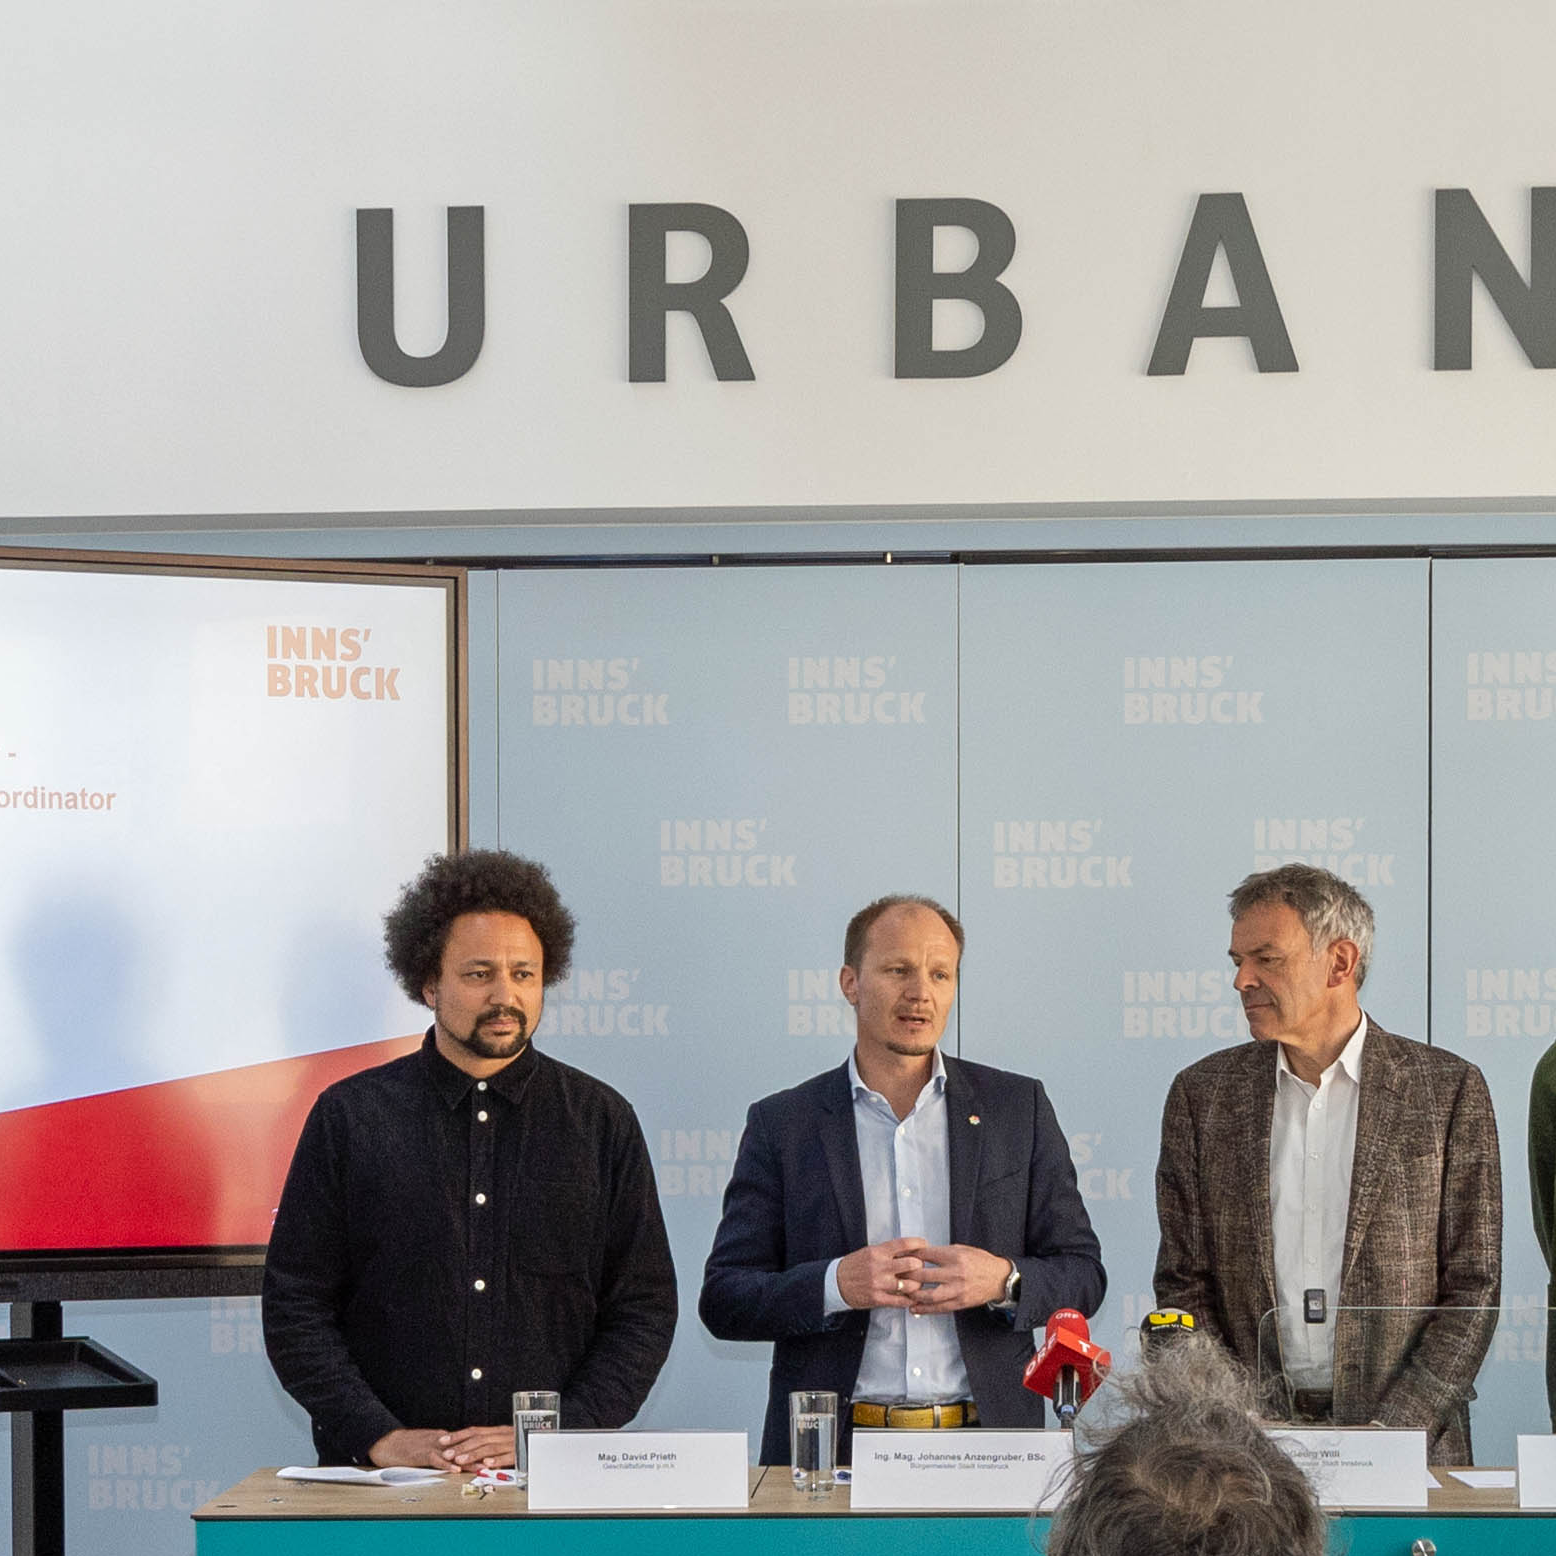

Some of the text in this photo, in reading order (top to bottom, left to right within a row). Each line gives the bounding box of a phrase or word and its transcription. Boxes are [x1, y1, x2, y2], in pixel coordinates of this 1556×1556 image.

[267, 626, 371, 661] INNS'
[267, 664, 400, 700] BRUCK
[532, 657, 640, 690] INNS'
[788, 656, 896, 690] INNS'
[1124, 655, 1234, 689] INNS'
[532, 693, 671, 727] BRUCK
[788, 692, 926, 725] BRUCK
[1124, 691, 1265, 725] BRUCK
[660, 818, 768, 852] INNS'
[993, 819, 1103, 853] INNS'
[1253, 816, 1367, 851] INNS'
[660, 855, 798, 888] BRUCK
[993, 855, 1134, 889] BRUCK
[88, 1445, 190, 1476] INNS'
[622, 1452, 647, 1461] David
[650, 1452, 677, 1461] Prieth
[918, 1452, 962, 1462] Johannes
[964, 1452, 1025, 1463] Anzengruber,
[1027, 1452, 1046, 1462] BSc
[1320, 1449, 1340, 1458] Willi
